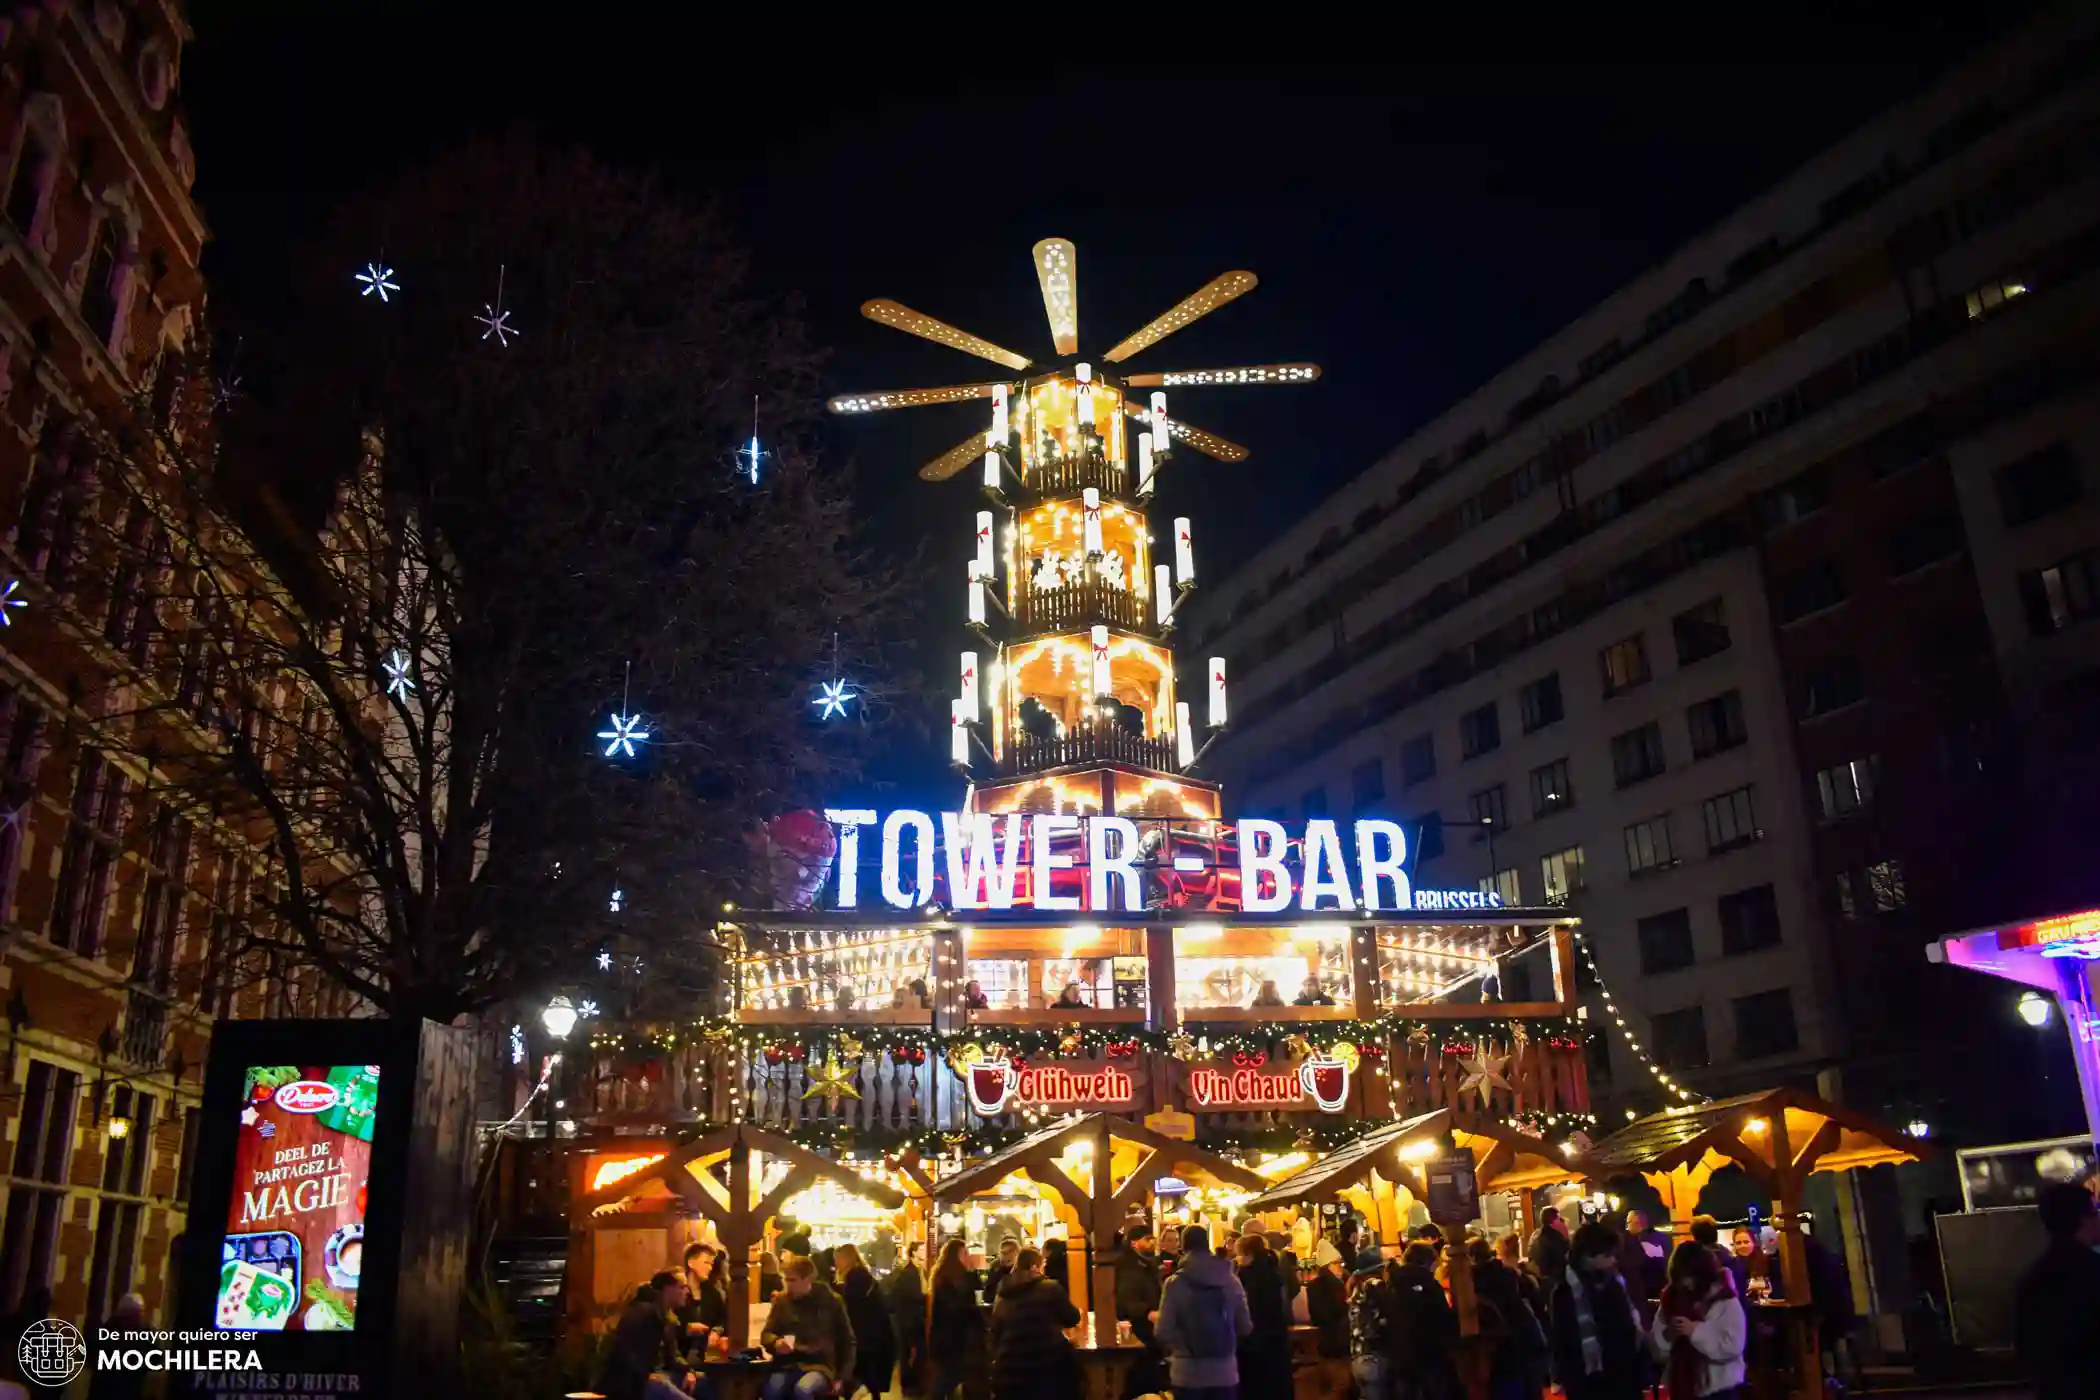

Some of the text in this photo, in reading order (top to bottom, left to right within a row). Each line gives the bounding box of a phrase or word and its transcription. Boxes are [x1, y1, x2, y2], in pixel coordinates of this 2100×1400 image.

[824, 808, 1143, 912] TOWER
[1238, 818, 1412, 912] BAR
[1415, 890, 1501, 909] BRUSSELS
[1018, 1065, 1133, 1103] Glühwein
[1191, 1068, 1304, 1105] Vin Chaud
[275, 1142, 331, 1165] DEEL DE
[254, 1156, 346, 1185] PARTAGEZ LA
[240, 1172, 352, 1224] MAGIE
[1748, 1207, 1758, 1222] P
[193, 1371, 281, 1391] PLAISIRS
